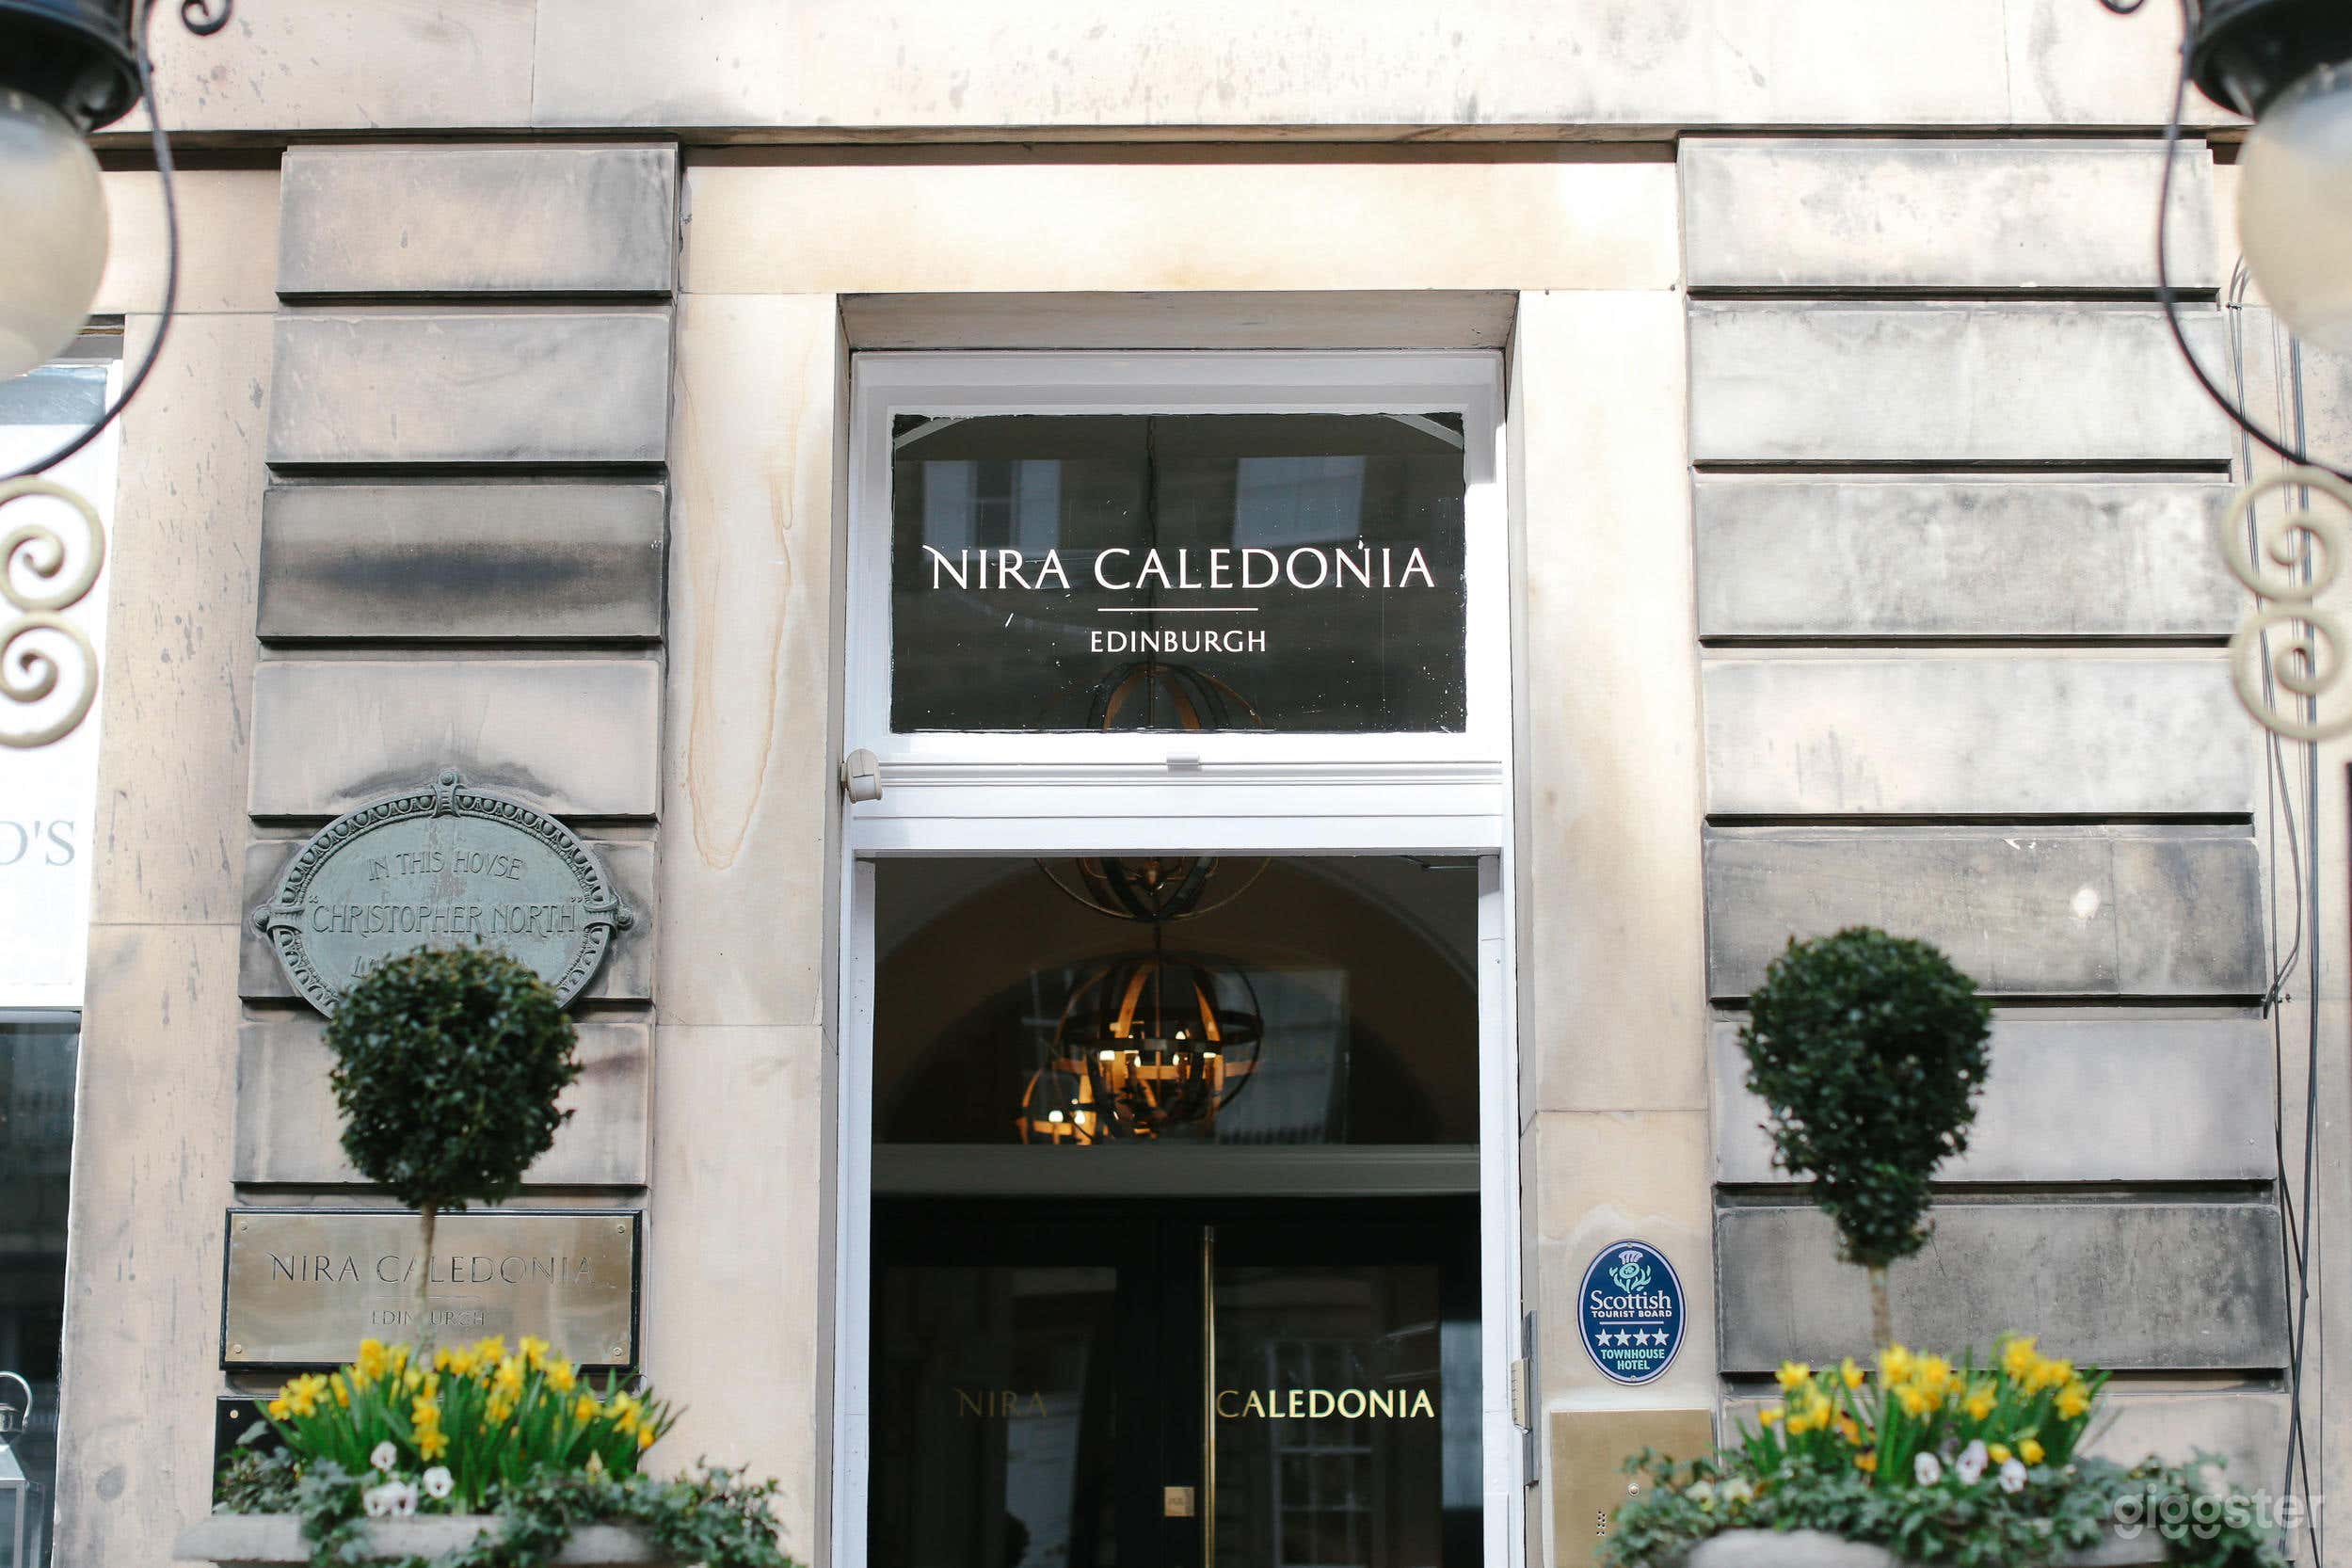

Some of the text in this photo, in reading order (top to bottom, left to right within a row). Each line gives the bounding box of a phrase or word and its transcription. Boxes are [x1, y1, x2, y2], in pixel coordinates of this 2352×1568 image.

[922, 544, 1436, 590] NIRA CALEDONIA
[1090, 630, 1266, 653] EDINBURGH
[367, 856, 390, 881] IN
[395, 850, 444, 876] THIS
[264, 1252, 360, 1284] NIRA
[1590, 1289, 1672, 1310] Scottish
[1600, 1349, 1665, 1360] TOWNHOUSE
[1617, 1360, 1650, 1370] HOTEL
[952, 1387, 1435, 1419] NIRA CALEDONIA
